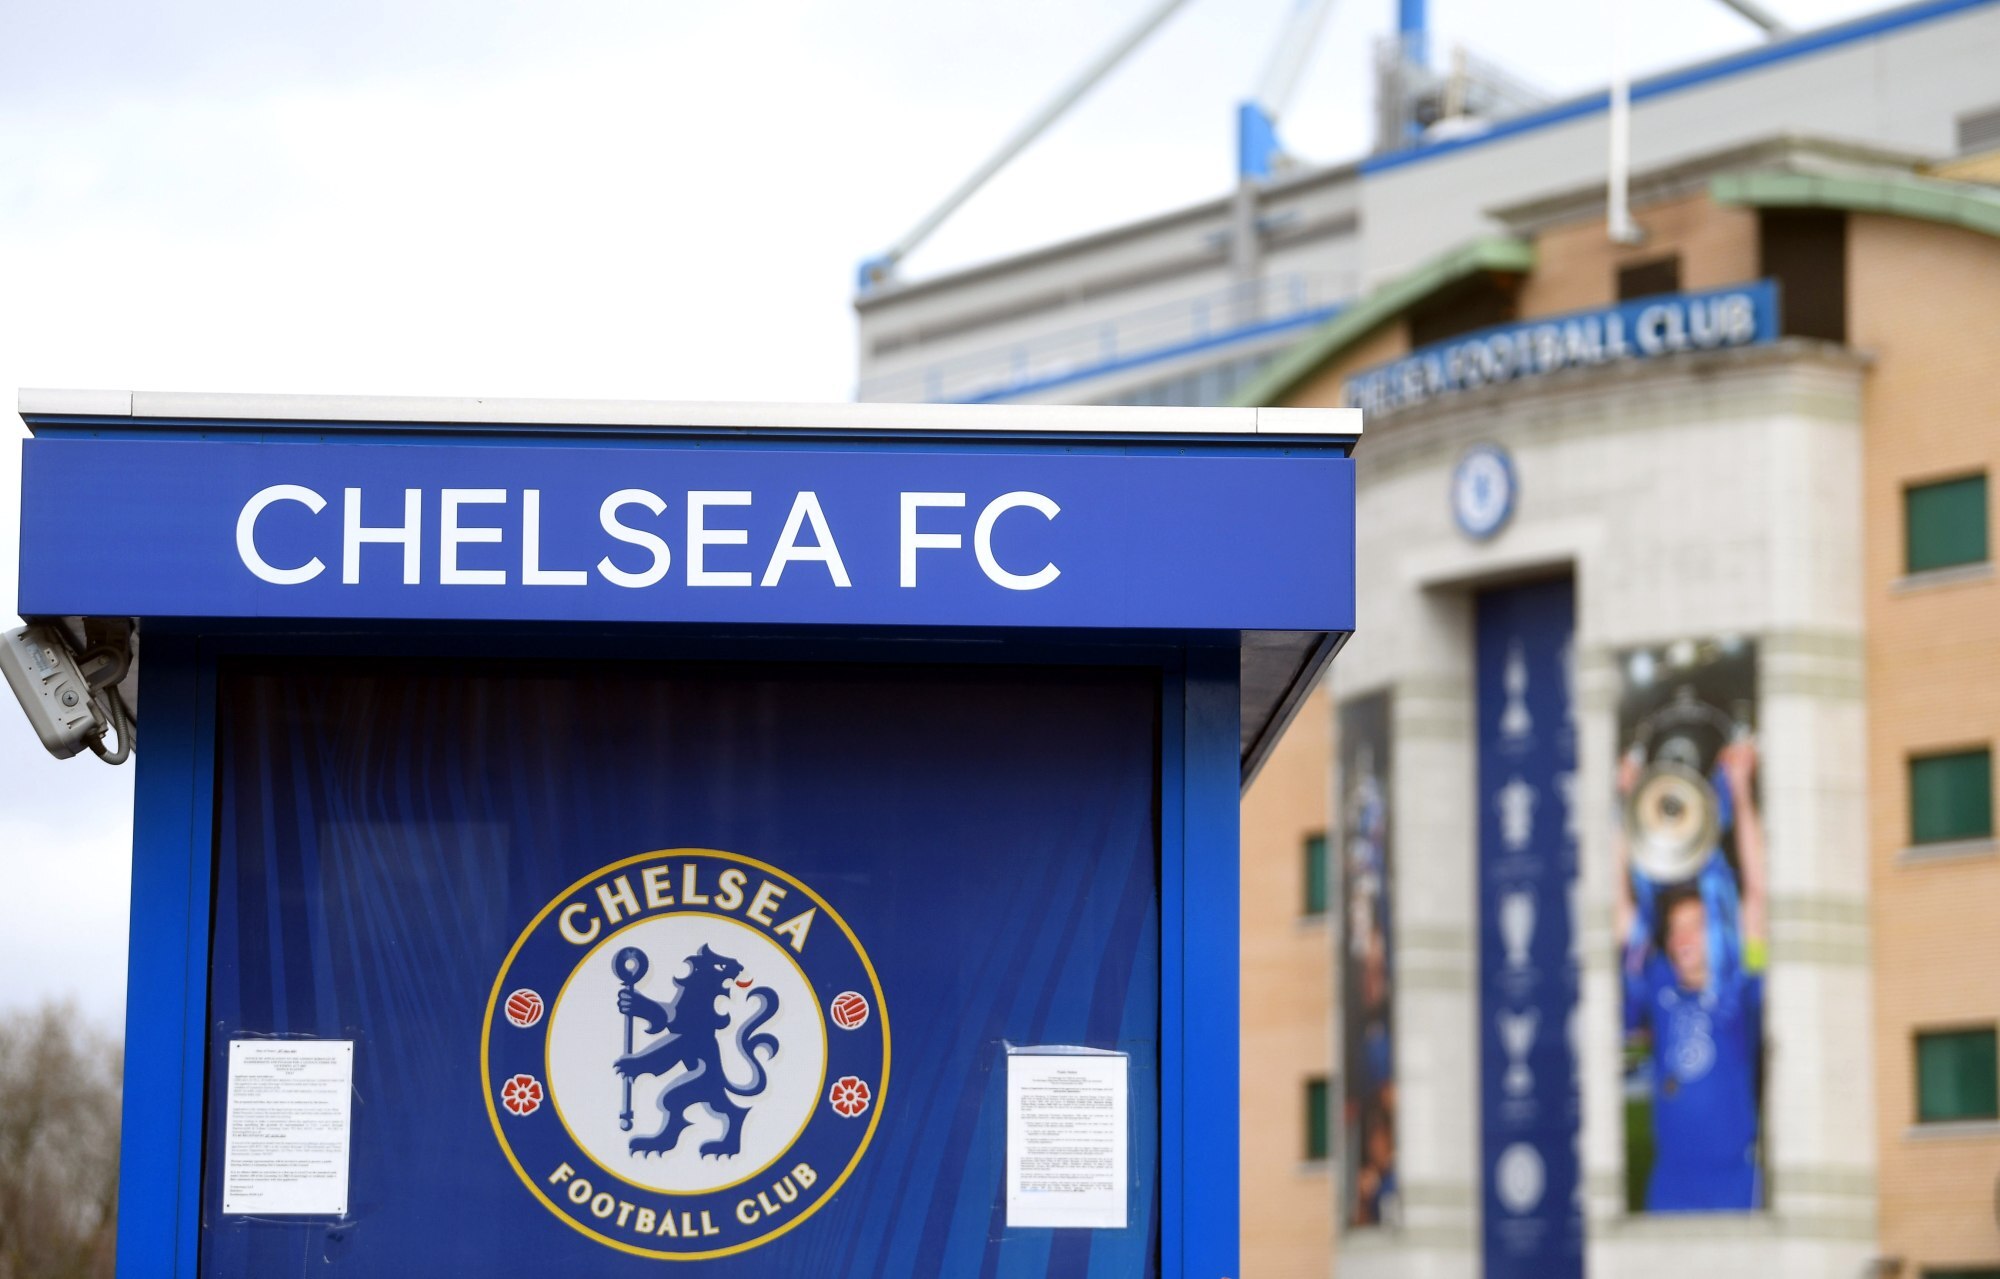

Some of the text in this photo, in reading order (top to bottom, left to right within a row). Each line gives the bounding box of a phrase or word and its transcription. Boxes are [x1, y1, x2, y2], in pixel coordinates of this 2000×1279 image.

[1636, 294, 1755, 355] CLUB
[236, 484, 1061, 591] CHELSEA FC
[558, 863, 817, 953] CHELSEA
[548, 1162, 818, 1238] FOOTBALL CLUB
